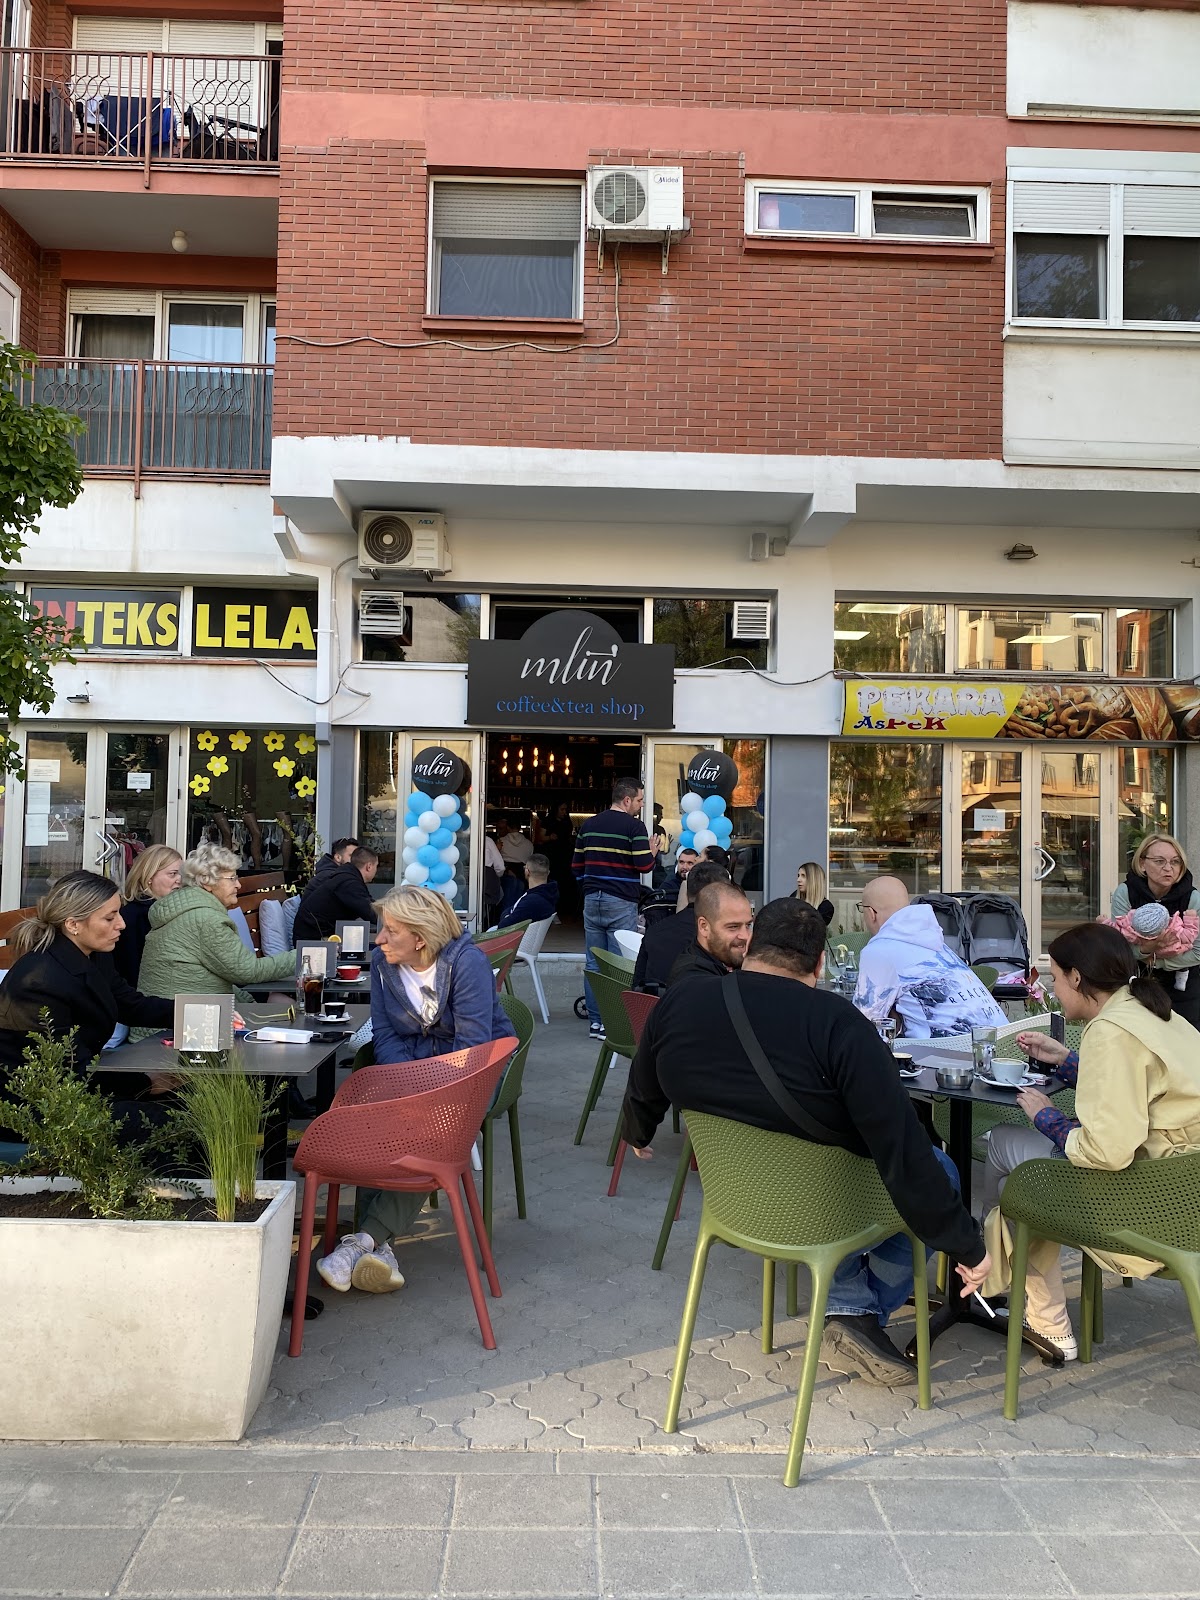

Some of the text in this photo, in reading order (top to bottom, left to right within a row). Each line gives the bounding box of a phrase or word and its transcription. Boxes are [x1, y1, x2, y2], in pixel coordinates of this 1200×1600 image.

[195, 603, 317, 650] LELA
[520, 625, 623, 686] mlin
[496, 695, 645, 721] coffee&tea shop
[857, 685, 1007, 717] PEKARA
[414, 752, 455, 778] mlin
[688, 758, 721, 782] mlin
[948, 986, 988, 1004] REACH
